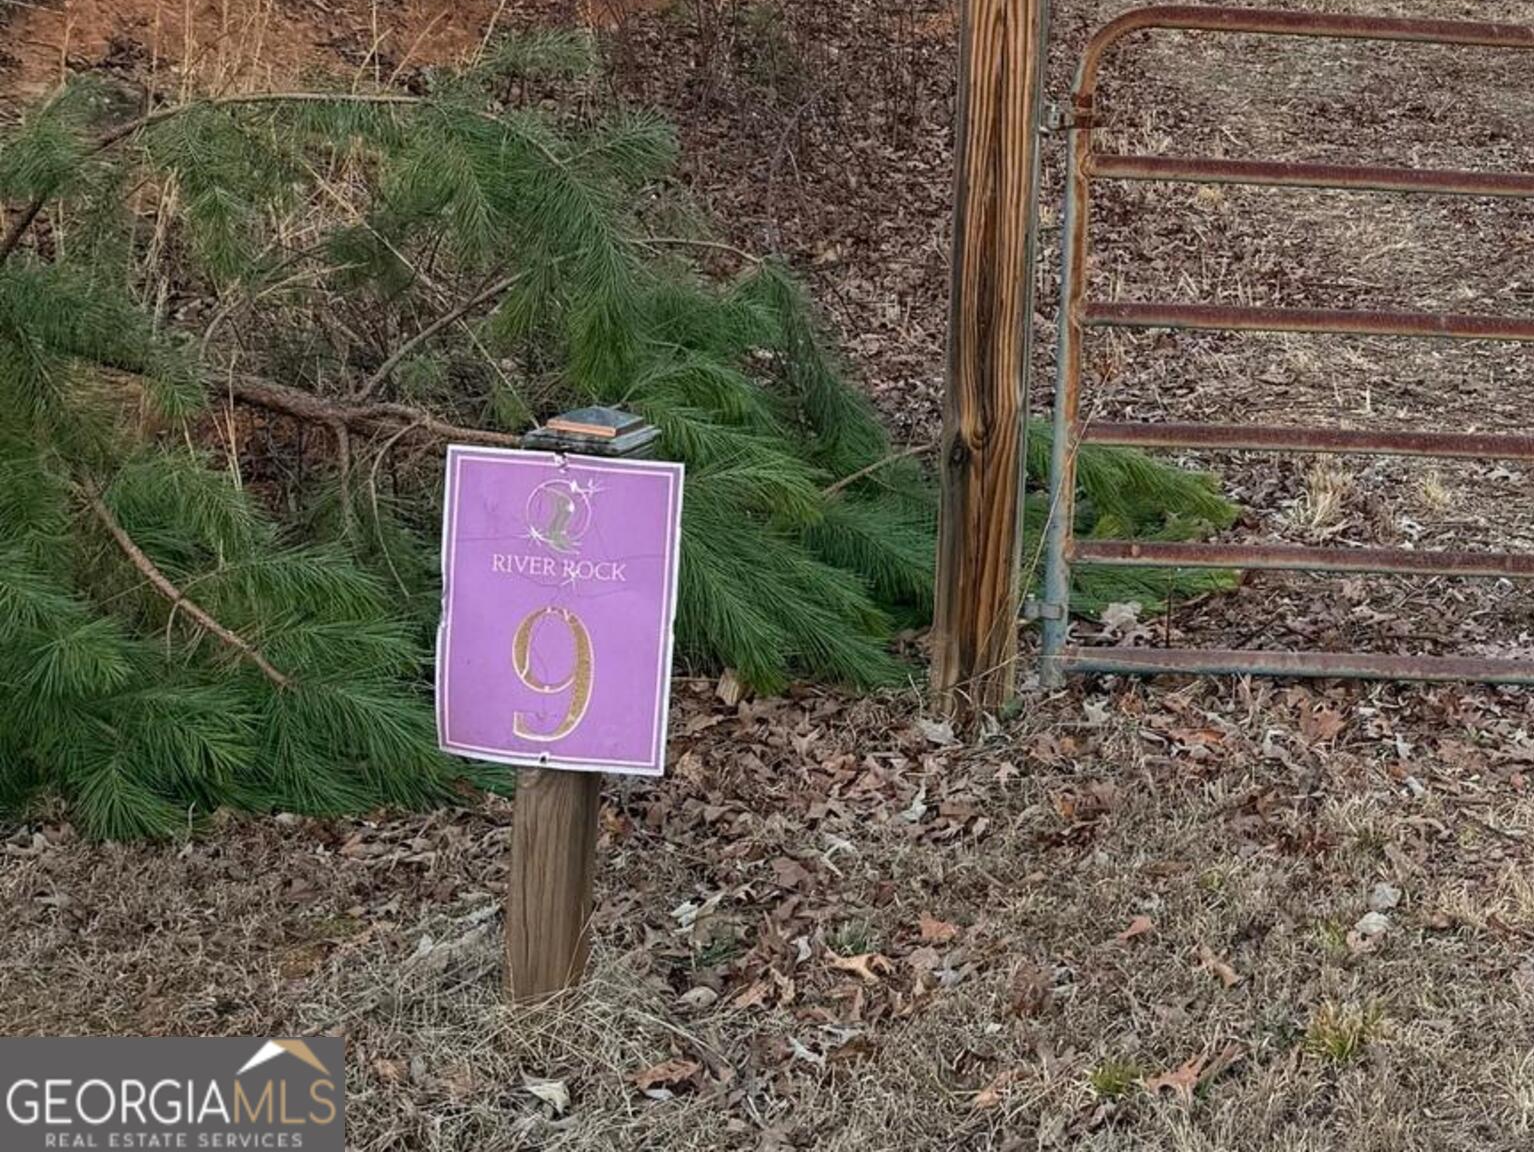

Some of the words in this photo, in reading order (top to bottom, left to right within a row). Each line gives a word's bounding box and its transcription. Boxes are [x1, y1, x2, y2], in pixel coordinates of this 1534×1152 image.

[492, 553, 556, 576] RIVER
[562, 559, 627, 582] ROCK
[512, 606, 595, 742] 9
